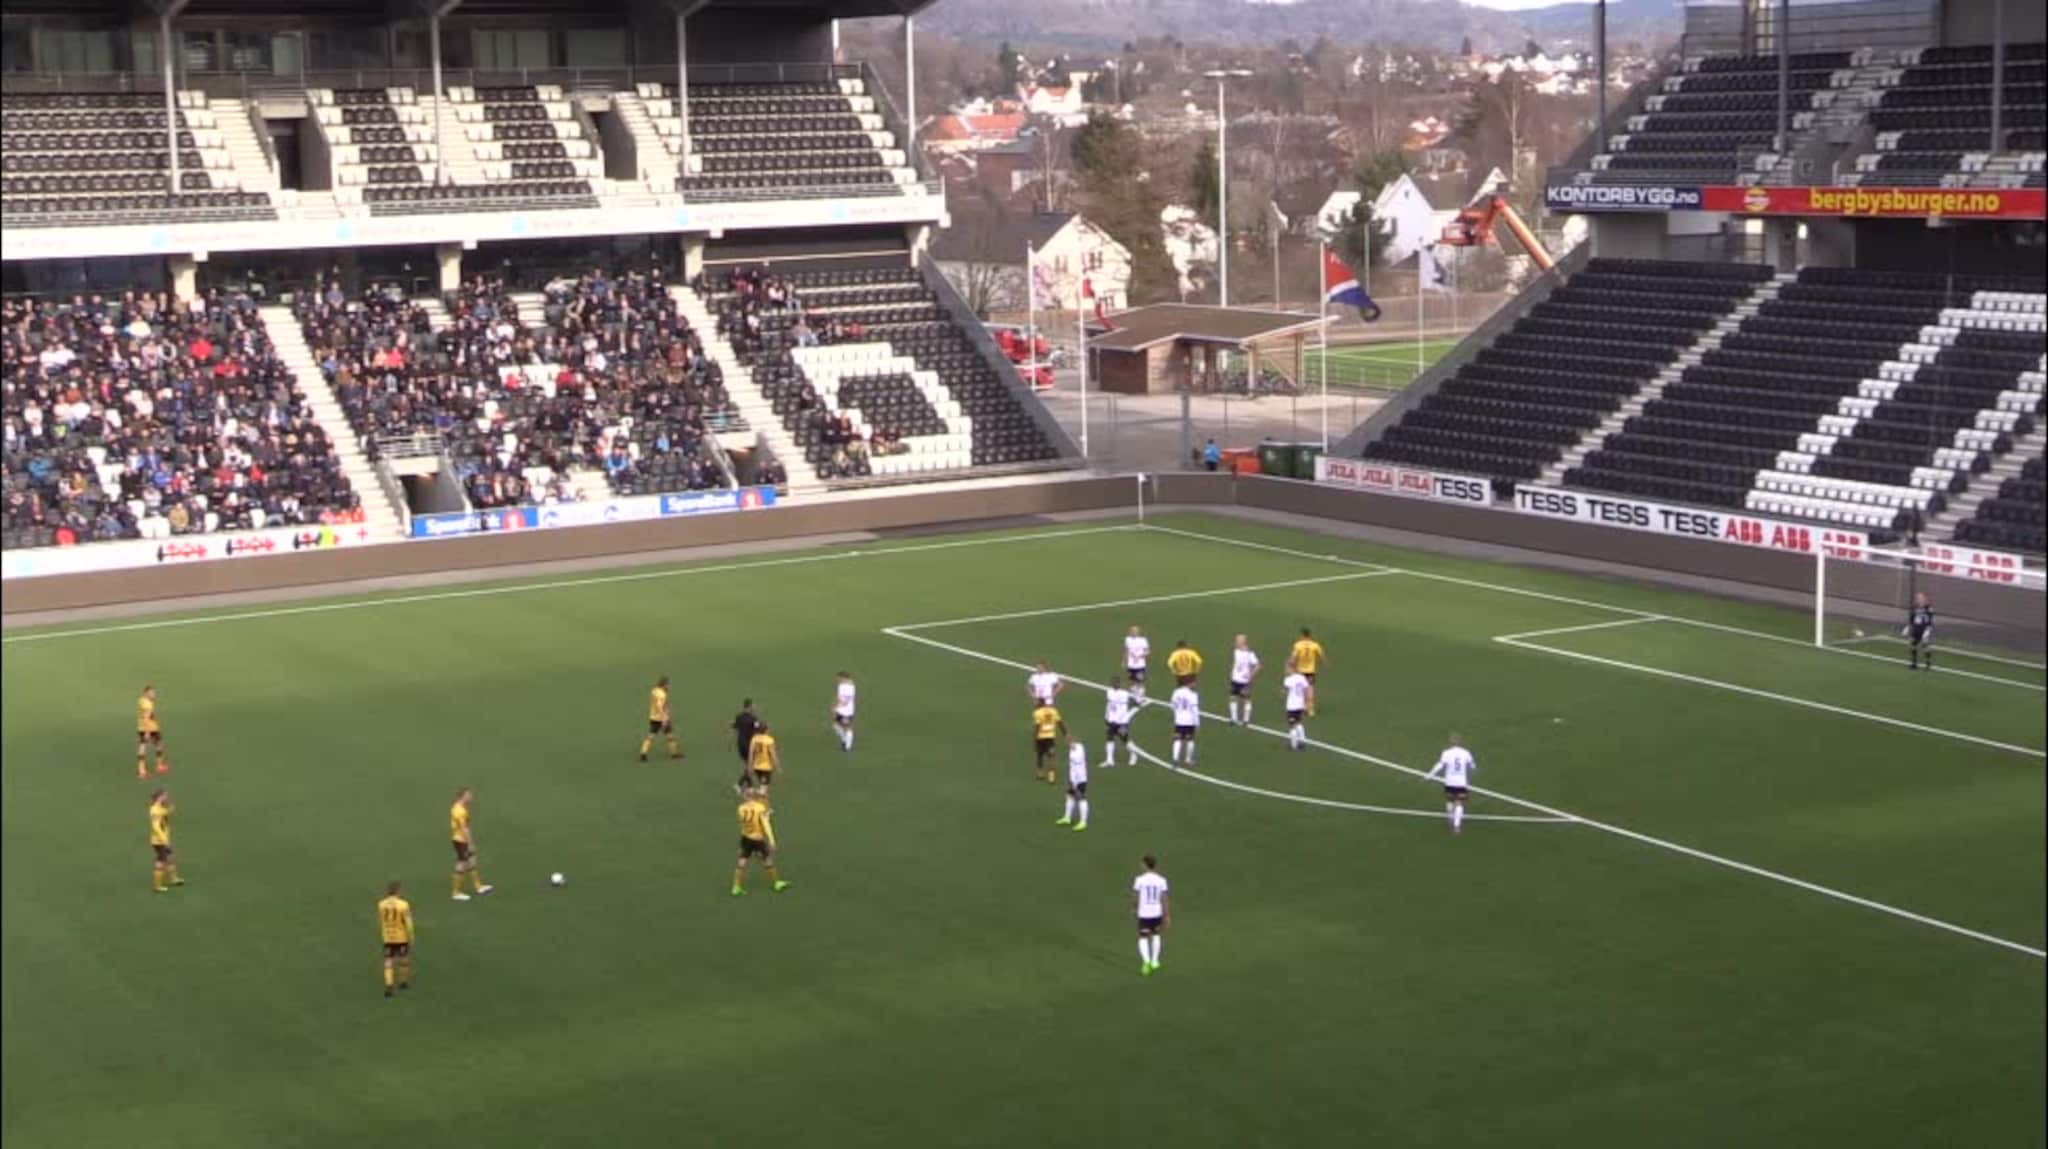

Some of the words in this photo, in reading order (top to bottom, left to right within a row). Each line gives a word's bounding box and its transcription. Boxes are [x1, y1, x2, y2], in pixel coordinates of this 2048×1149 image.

[1548, 186, 1699, 204] KONTORBYGG.no
[1809, 188, 2000, 214] bergbysburger.no
[1517, 489, 1577, 515] TESS
[1585, 499, 1649, 526] TESS
[1726, 518, 1762, 544] ABB
[1772, 525, 1810, 551] ABB
[1822, 532, 1860, 559] ABB
[1969, 553, 2014, 582] ABB
